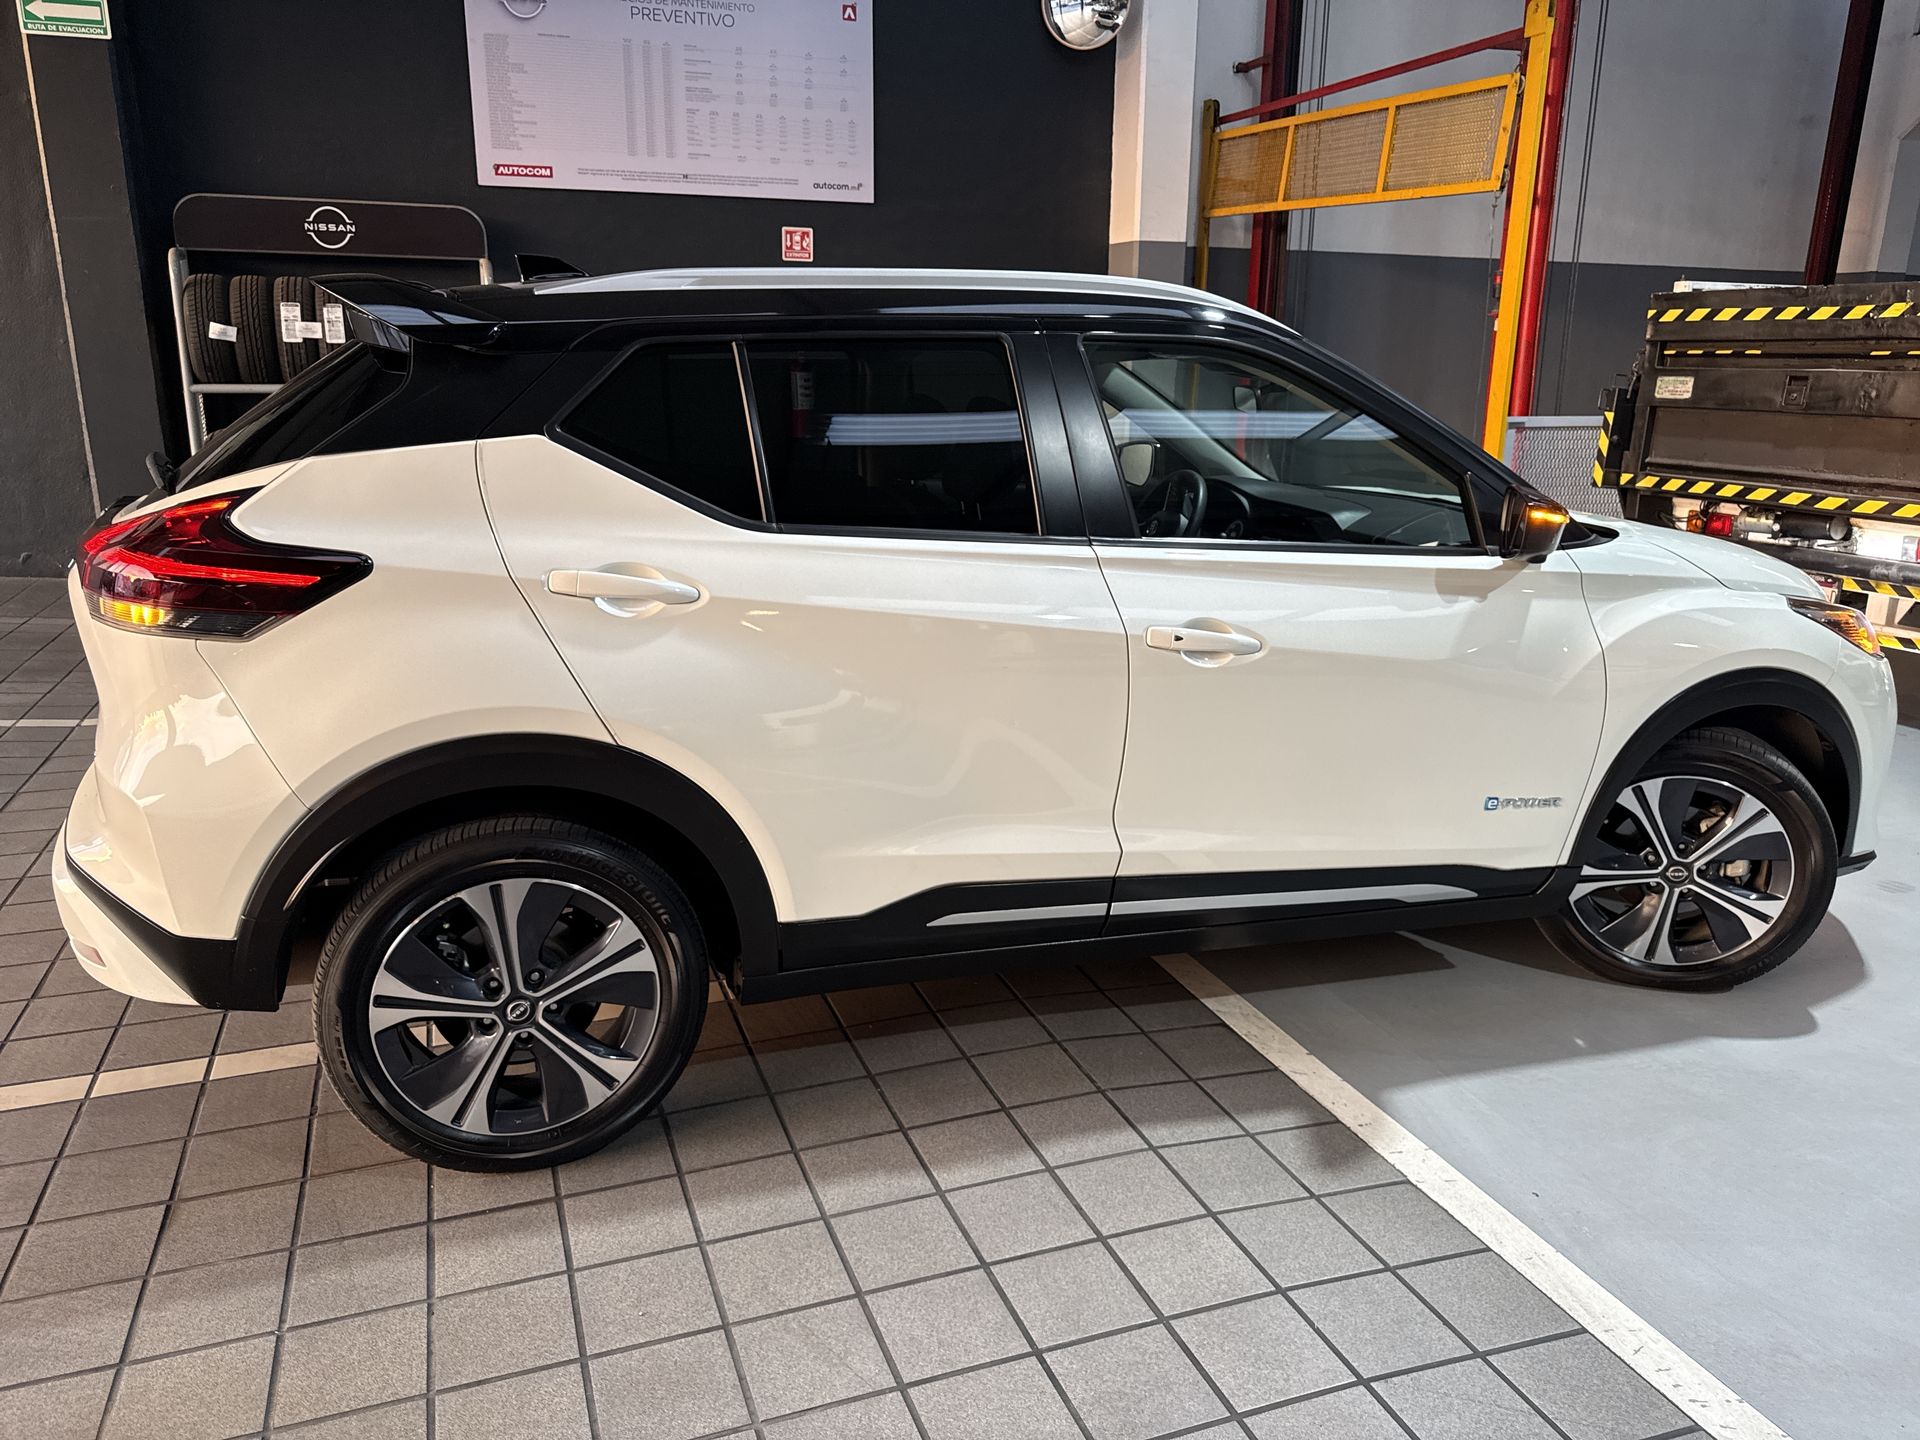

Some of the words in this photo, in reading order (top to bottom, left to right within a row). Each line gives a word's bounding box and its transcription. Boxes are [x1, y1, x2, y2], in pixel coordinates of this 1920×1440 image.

[671, 0, 755, 13] MANTENIMIENTO
[630, 6, 735, 28] PREVENTIVO
[27, 23, 46, 31] RUTA
[58, 26, 104, 34] EVACUACION
[497, 165, 551, 177] AUTOCOM
[304, 222, 356, 233] NISSAN
